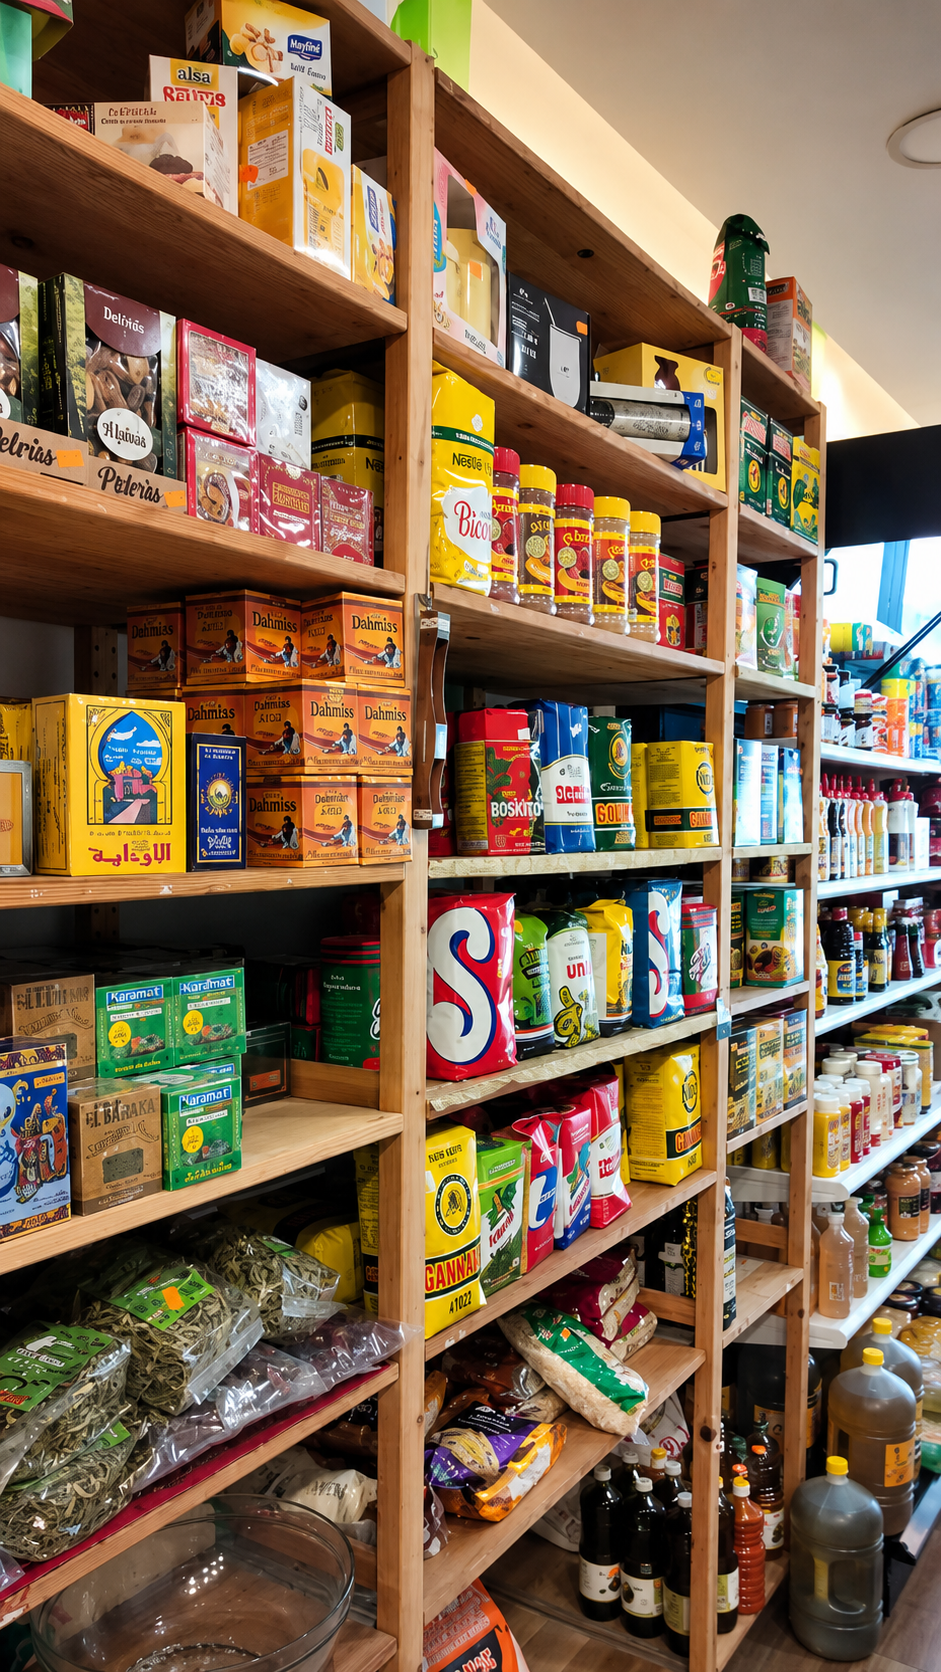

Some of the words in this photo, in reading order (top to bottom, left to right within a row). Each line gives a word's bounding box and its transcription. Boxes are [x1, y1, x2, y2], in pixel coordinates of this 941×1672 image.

[177, 66, 211, 84] alsa
[252, 611, 298, 633] Dahmiss
[351, 614, 398, 633] Dahmiss
[310, 701, 354, 718] Dahmiss
[364, 705, 407, 721] Dahmiss
[249, 797, 297, 813] Dahmiss
[111, 986, 160, 1002] Karamat
